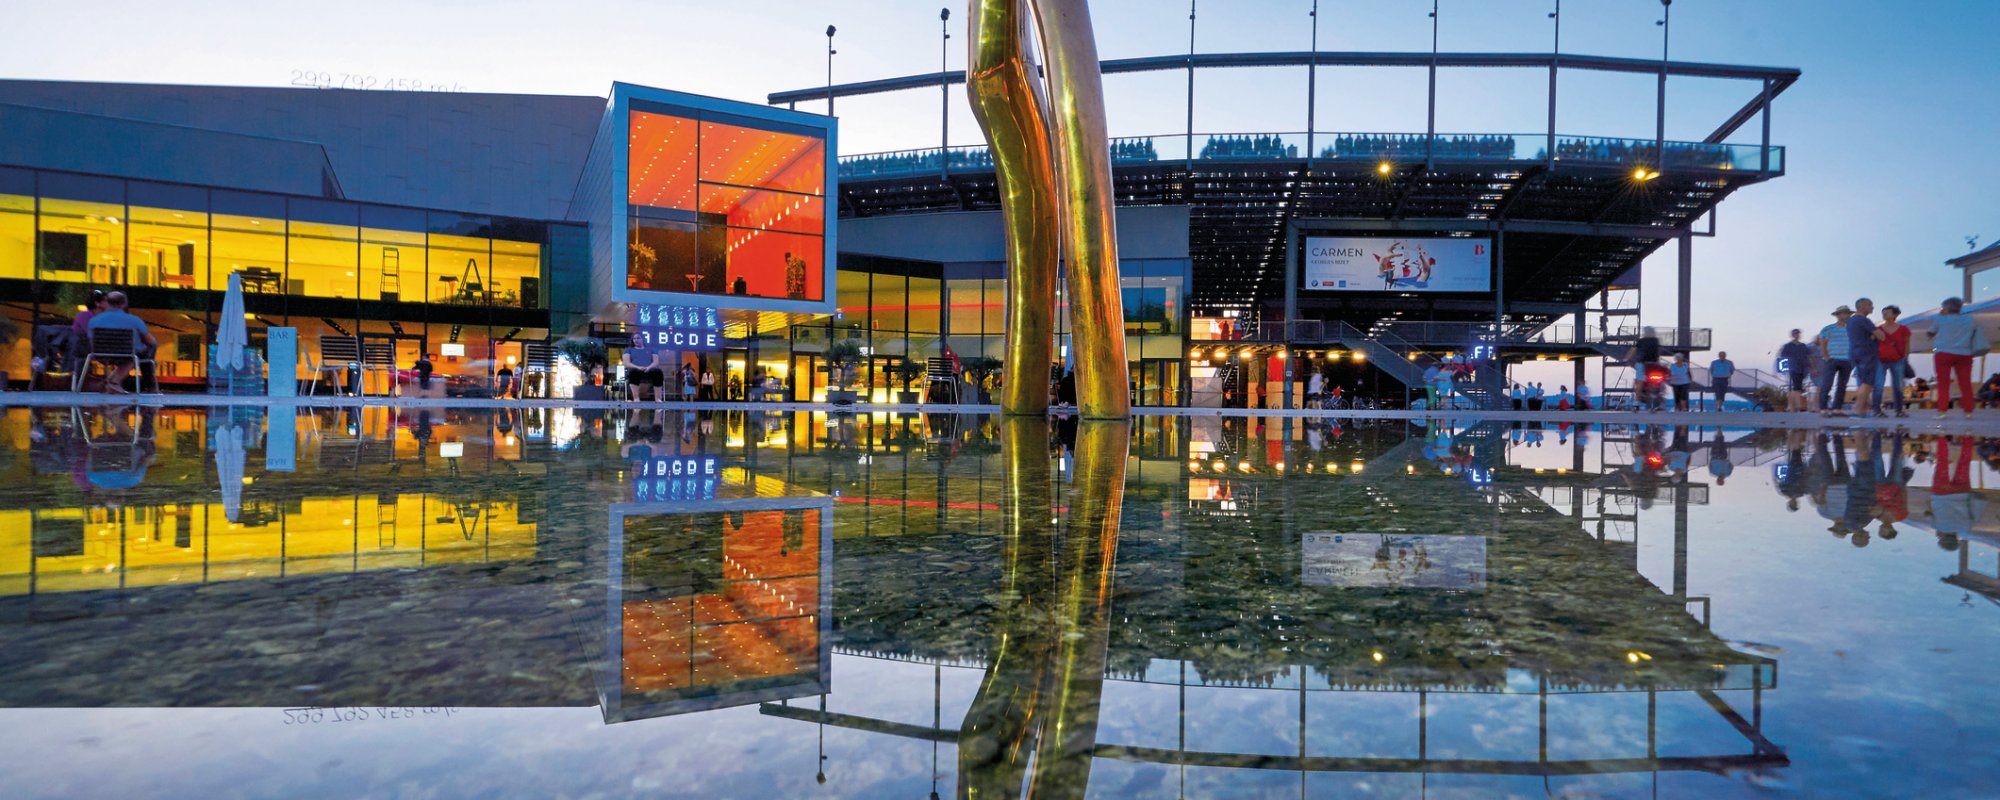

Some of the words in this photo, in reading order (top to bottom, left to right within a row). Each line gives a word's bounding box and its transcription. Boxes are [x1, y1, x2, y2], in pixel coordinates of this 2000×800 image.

[291, 69, 331, 88] 299
[339, 73, 377, 90] 792
[384, 78, 423, 92] 458
[1311, 247, 1363, 257] CARMEN
[1474, 244, 1485, 255] B
[269, 330, 289, 339] BAR
